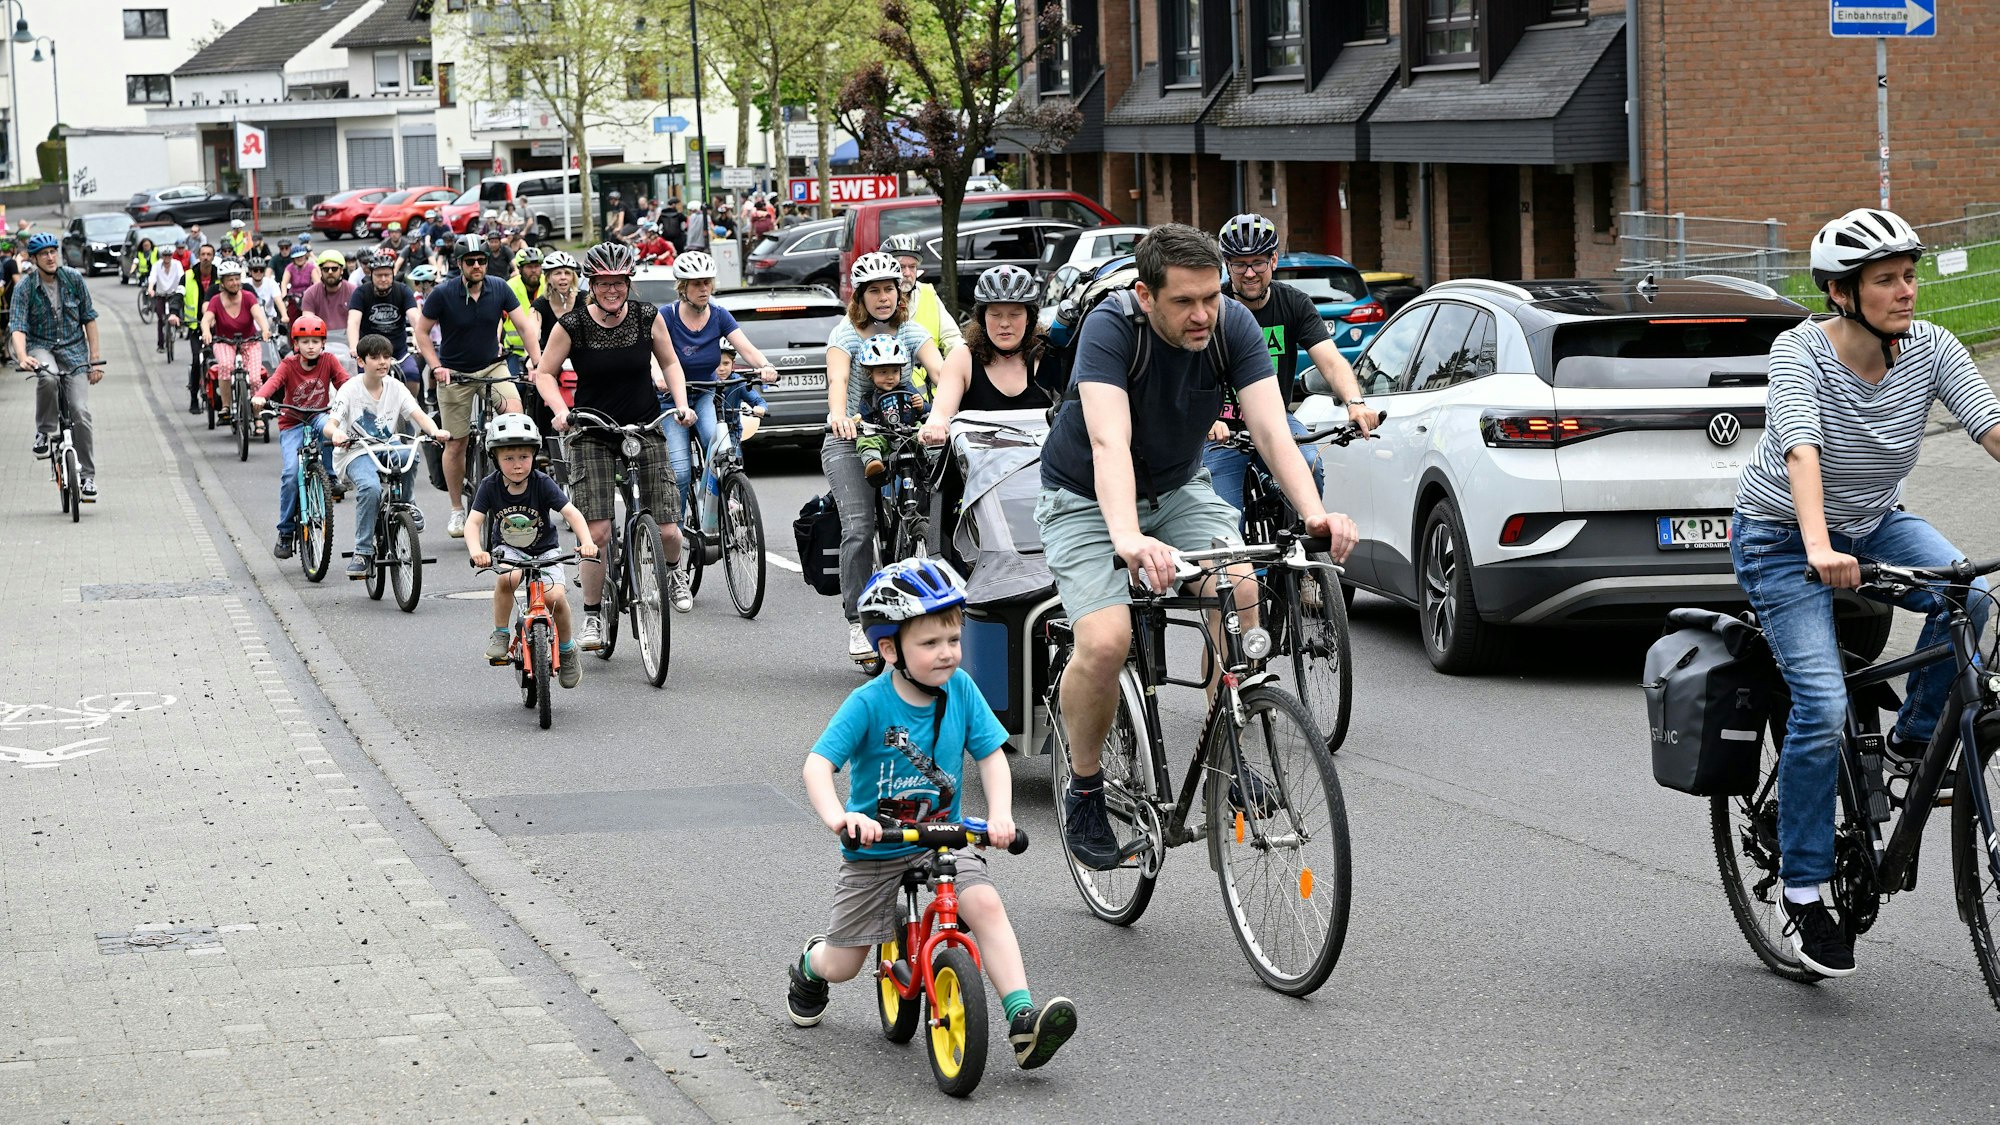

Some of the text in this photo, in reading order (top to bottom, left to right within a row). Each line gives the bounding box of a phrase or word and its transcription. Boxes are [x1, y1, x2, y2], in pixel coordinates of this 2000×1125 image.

[1837, 11, 1909, 20] Einbahnstraße
[794, 184, 805, 198] P
[787, 374, 825, 387] AJ 3319
[495, 505, 518, 519] FORCE
[1672, 520, 1686, 541] K
[1700, 519, 1728, 540] PJ
[1651, 727, 1679, 745] SIC
